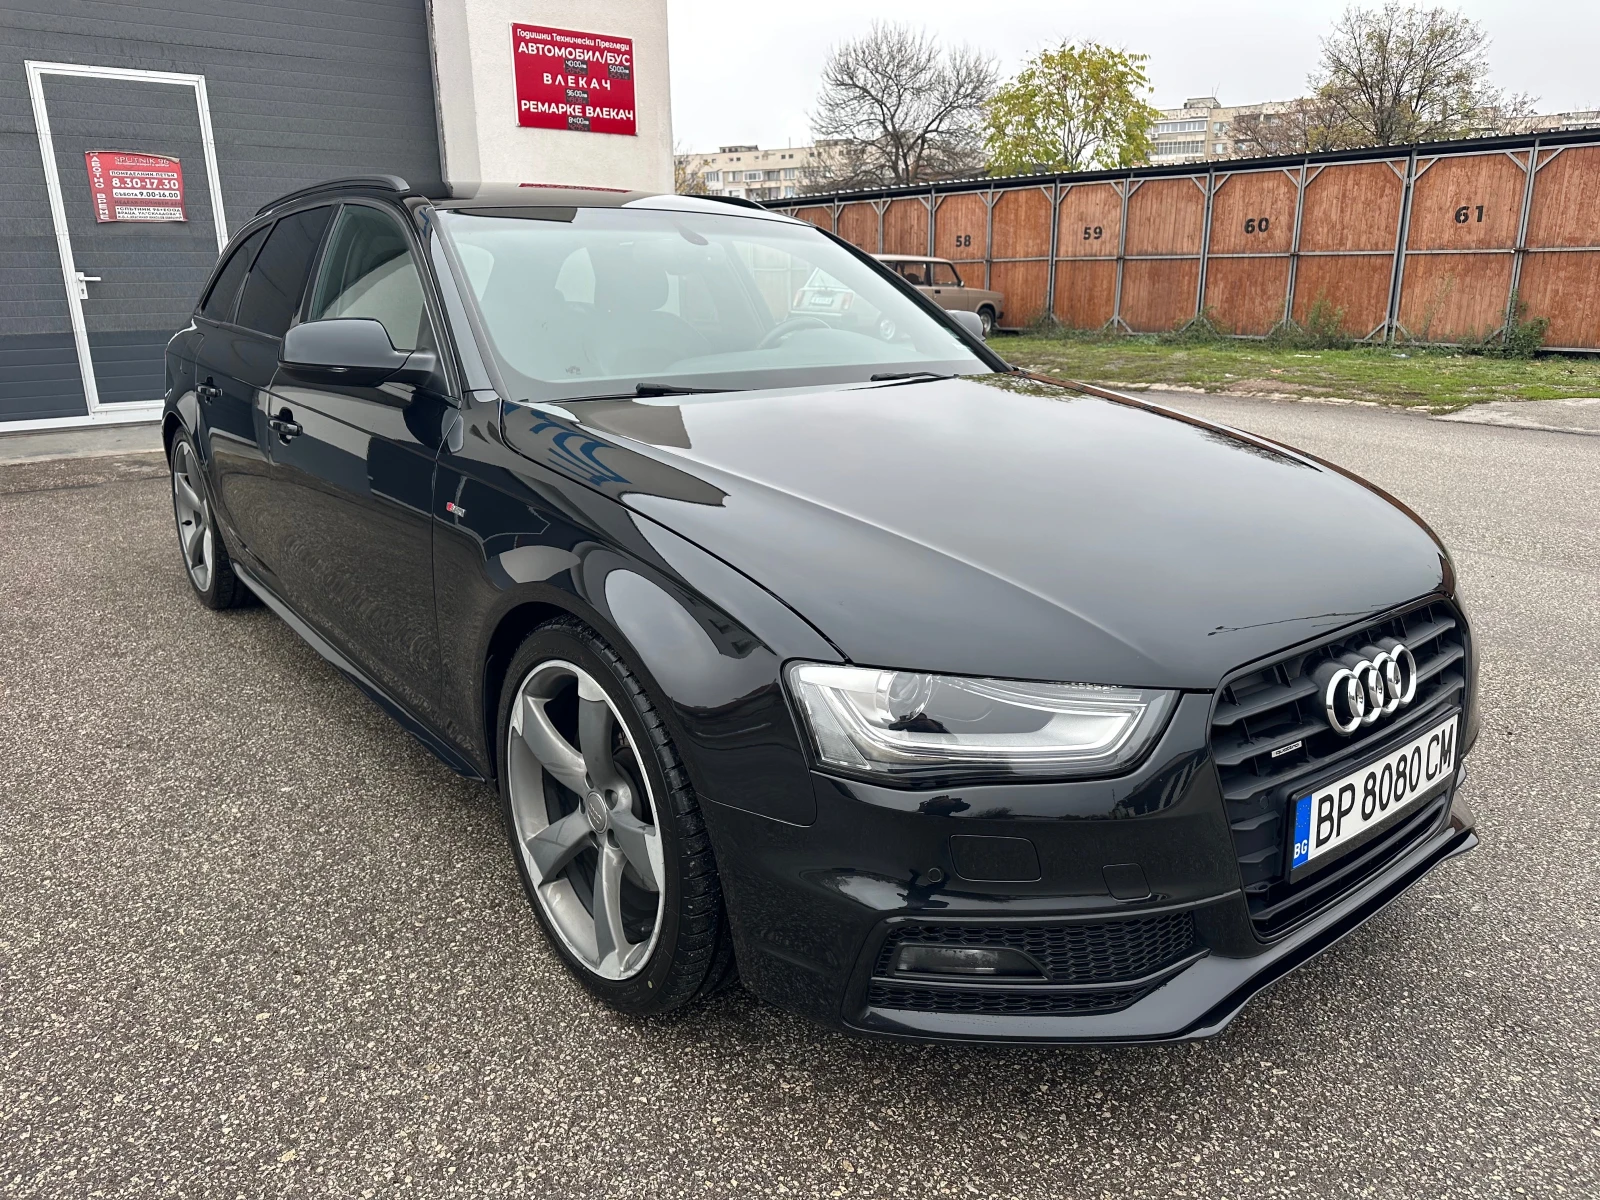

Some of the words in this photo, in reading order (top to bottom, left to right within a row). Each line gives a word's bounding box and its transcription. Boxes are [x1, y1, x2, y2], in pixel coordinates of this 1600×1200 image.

[517, 28, 551, 40] Годишни
[552, 33, 594, 46] Технически
[596, 39, 630, 51] Прегледи
[518, 41, 631, 66] АВТОМОБИЛ/БУС
[521, 99, 583, 117] РЕМАРКЕ
[586, 106, 634, 121] ВЛЕКАЧ
[114, 156, 156, 165] SPUTNIK
[112, 177, 179, 189] 8.30-17.30
[1454, 205, 1484, 224] 61
[1083, 226, 1103, 240] 59
[1244, 217, 1270, 234] 60
[955, 234, 971, 247] 58
[1293, 839, 1308, 859] BG
[1361, 745, 1422, 822] 8080
[1425, 723, 1454, 782] CM
